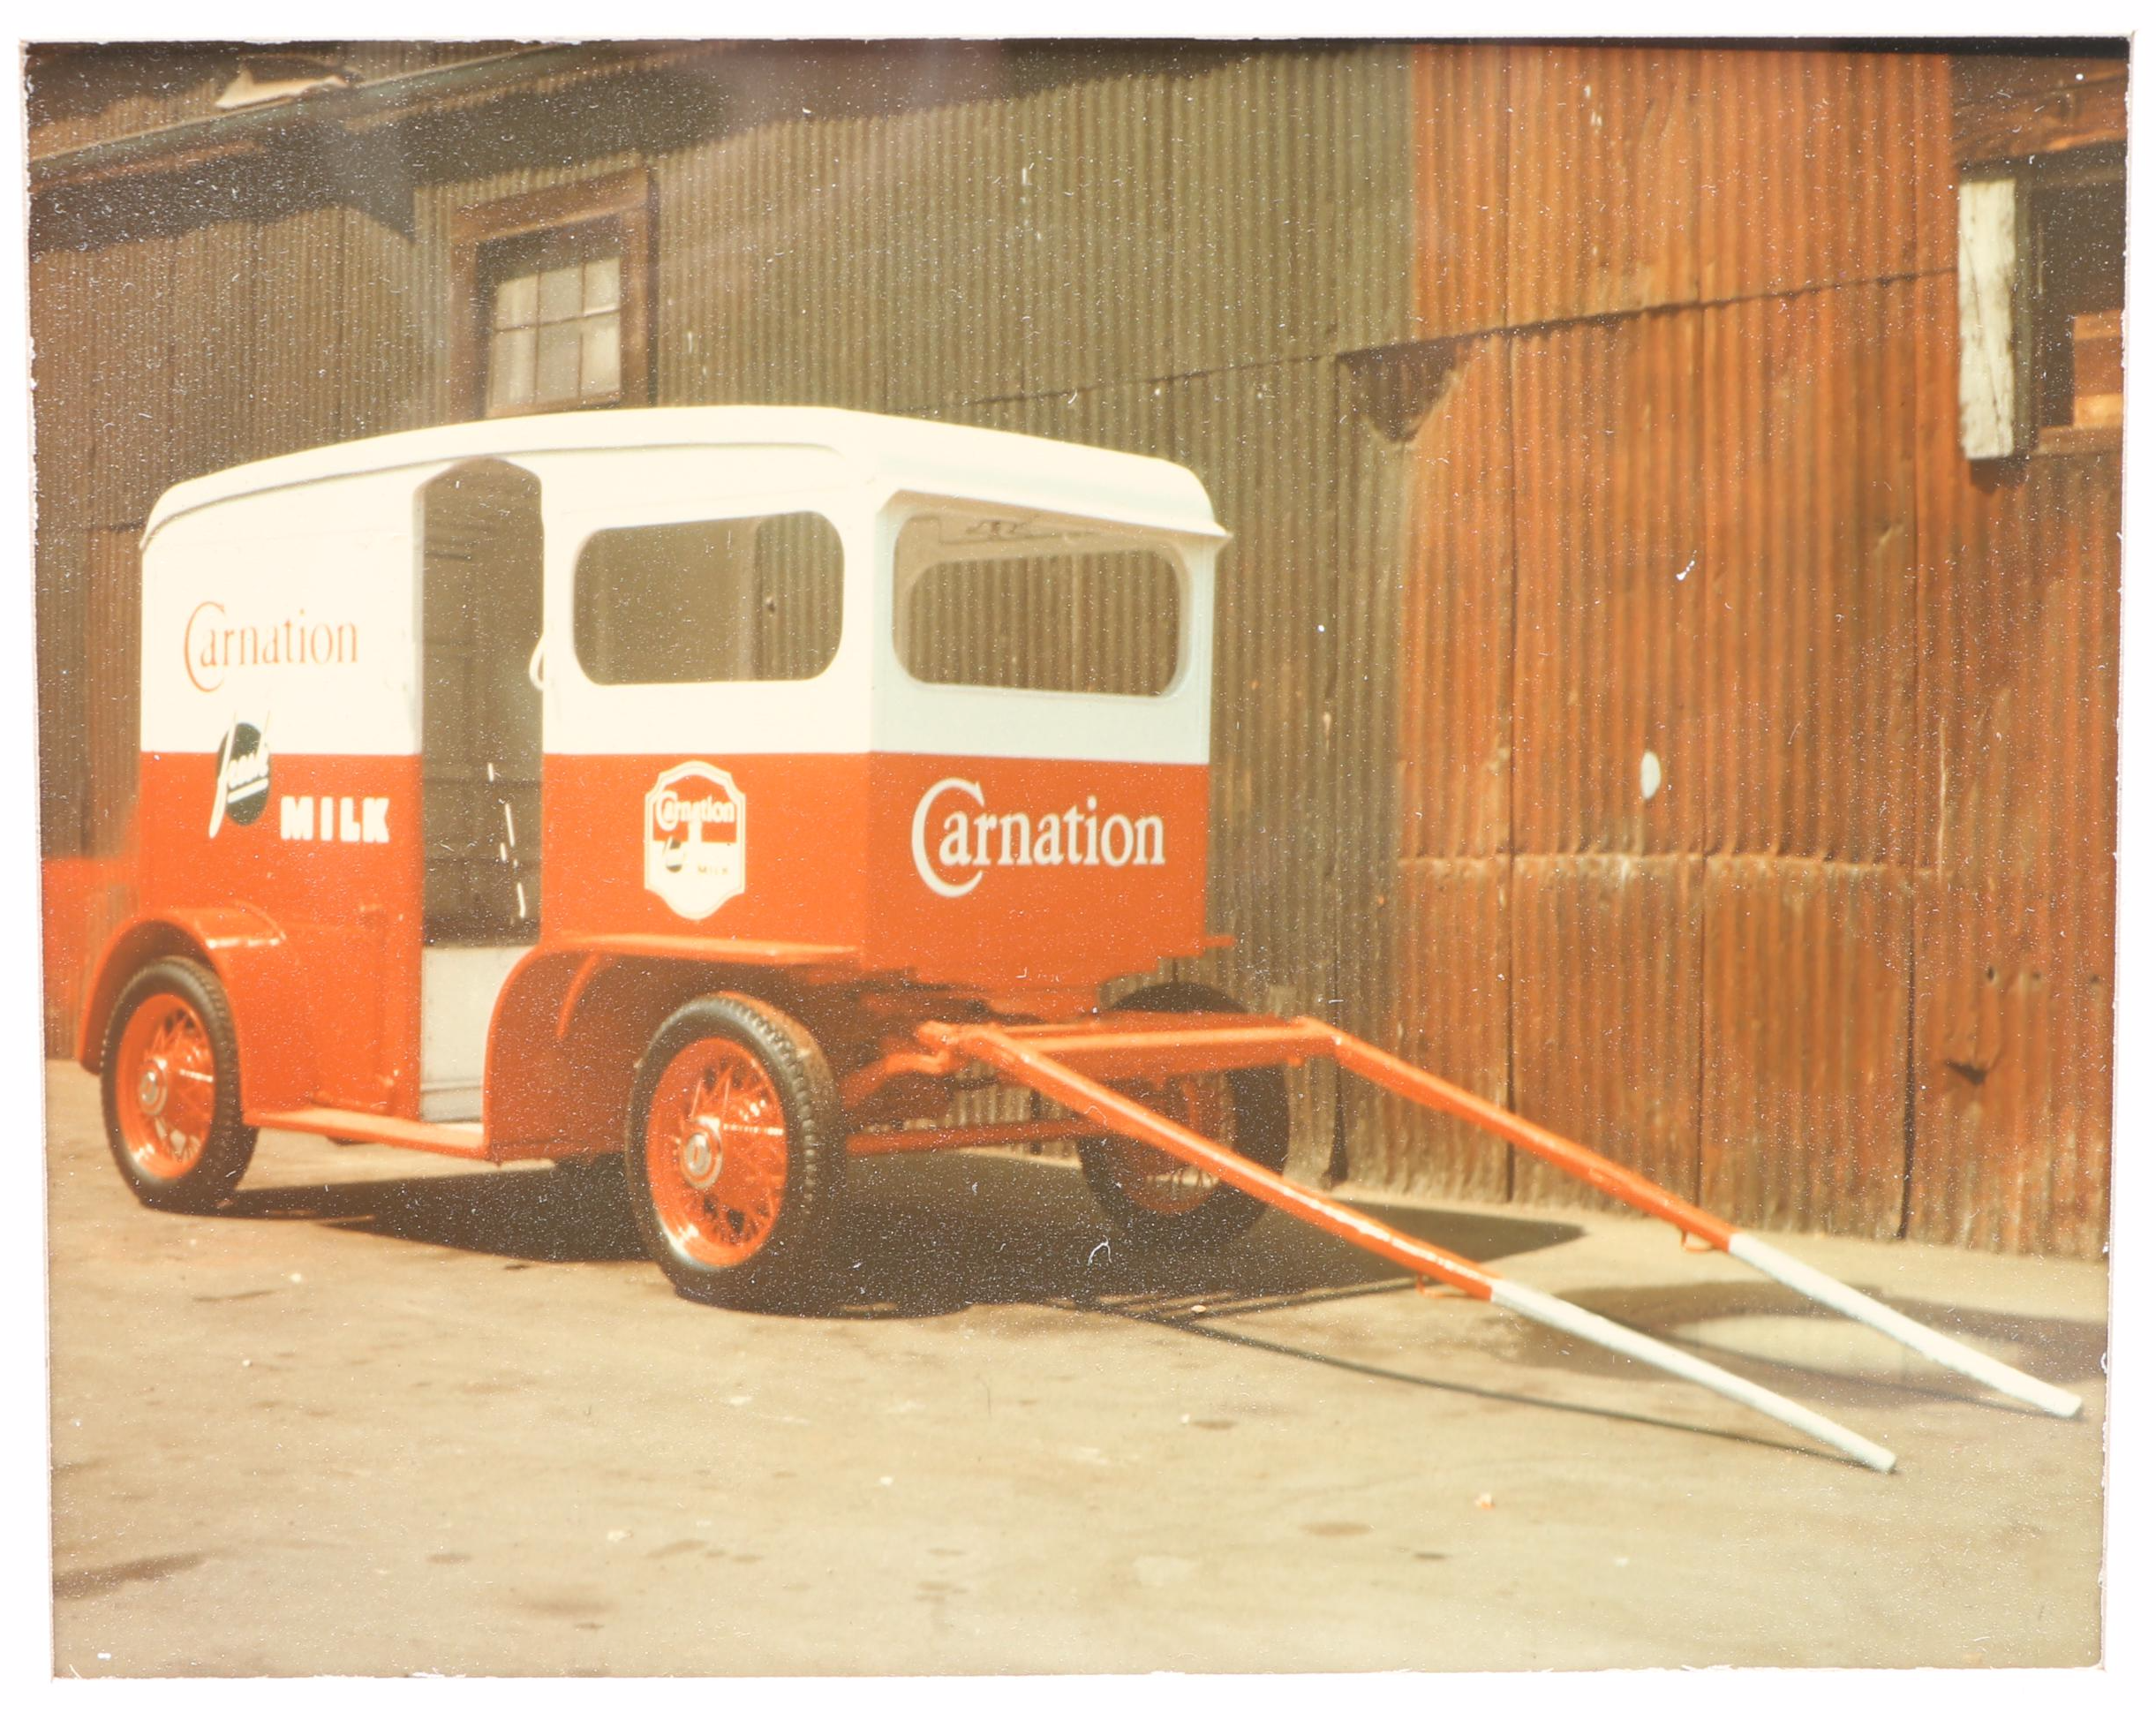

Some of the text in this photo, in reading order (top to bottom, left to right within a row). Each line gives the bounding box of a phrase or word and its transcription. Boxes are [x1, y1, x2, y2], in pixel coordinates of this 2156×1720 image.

[184, 601, 358, 692] Carnation
[279, 796, 390, 843] MILK
[911, 776, 1165, 898] Carnation
